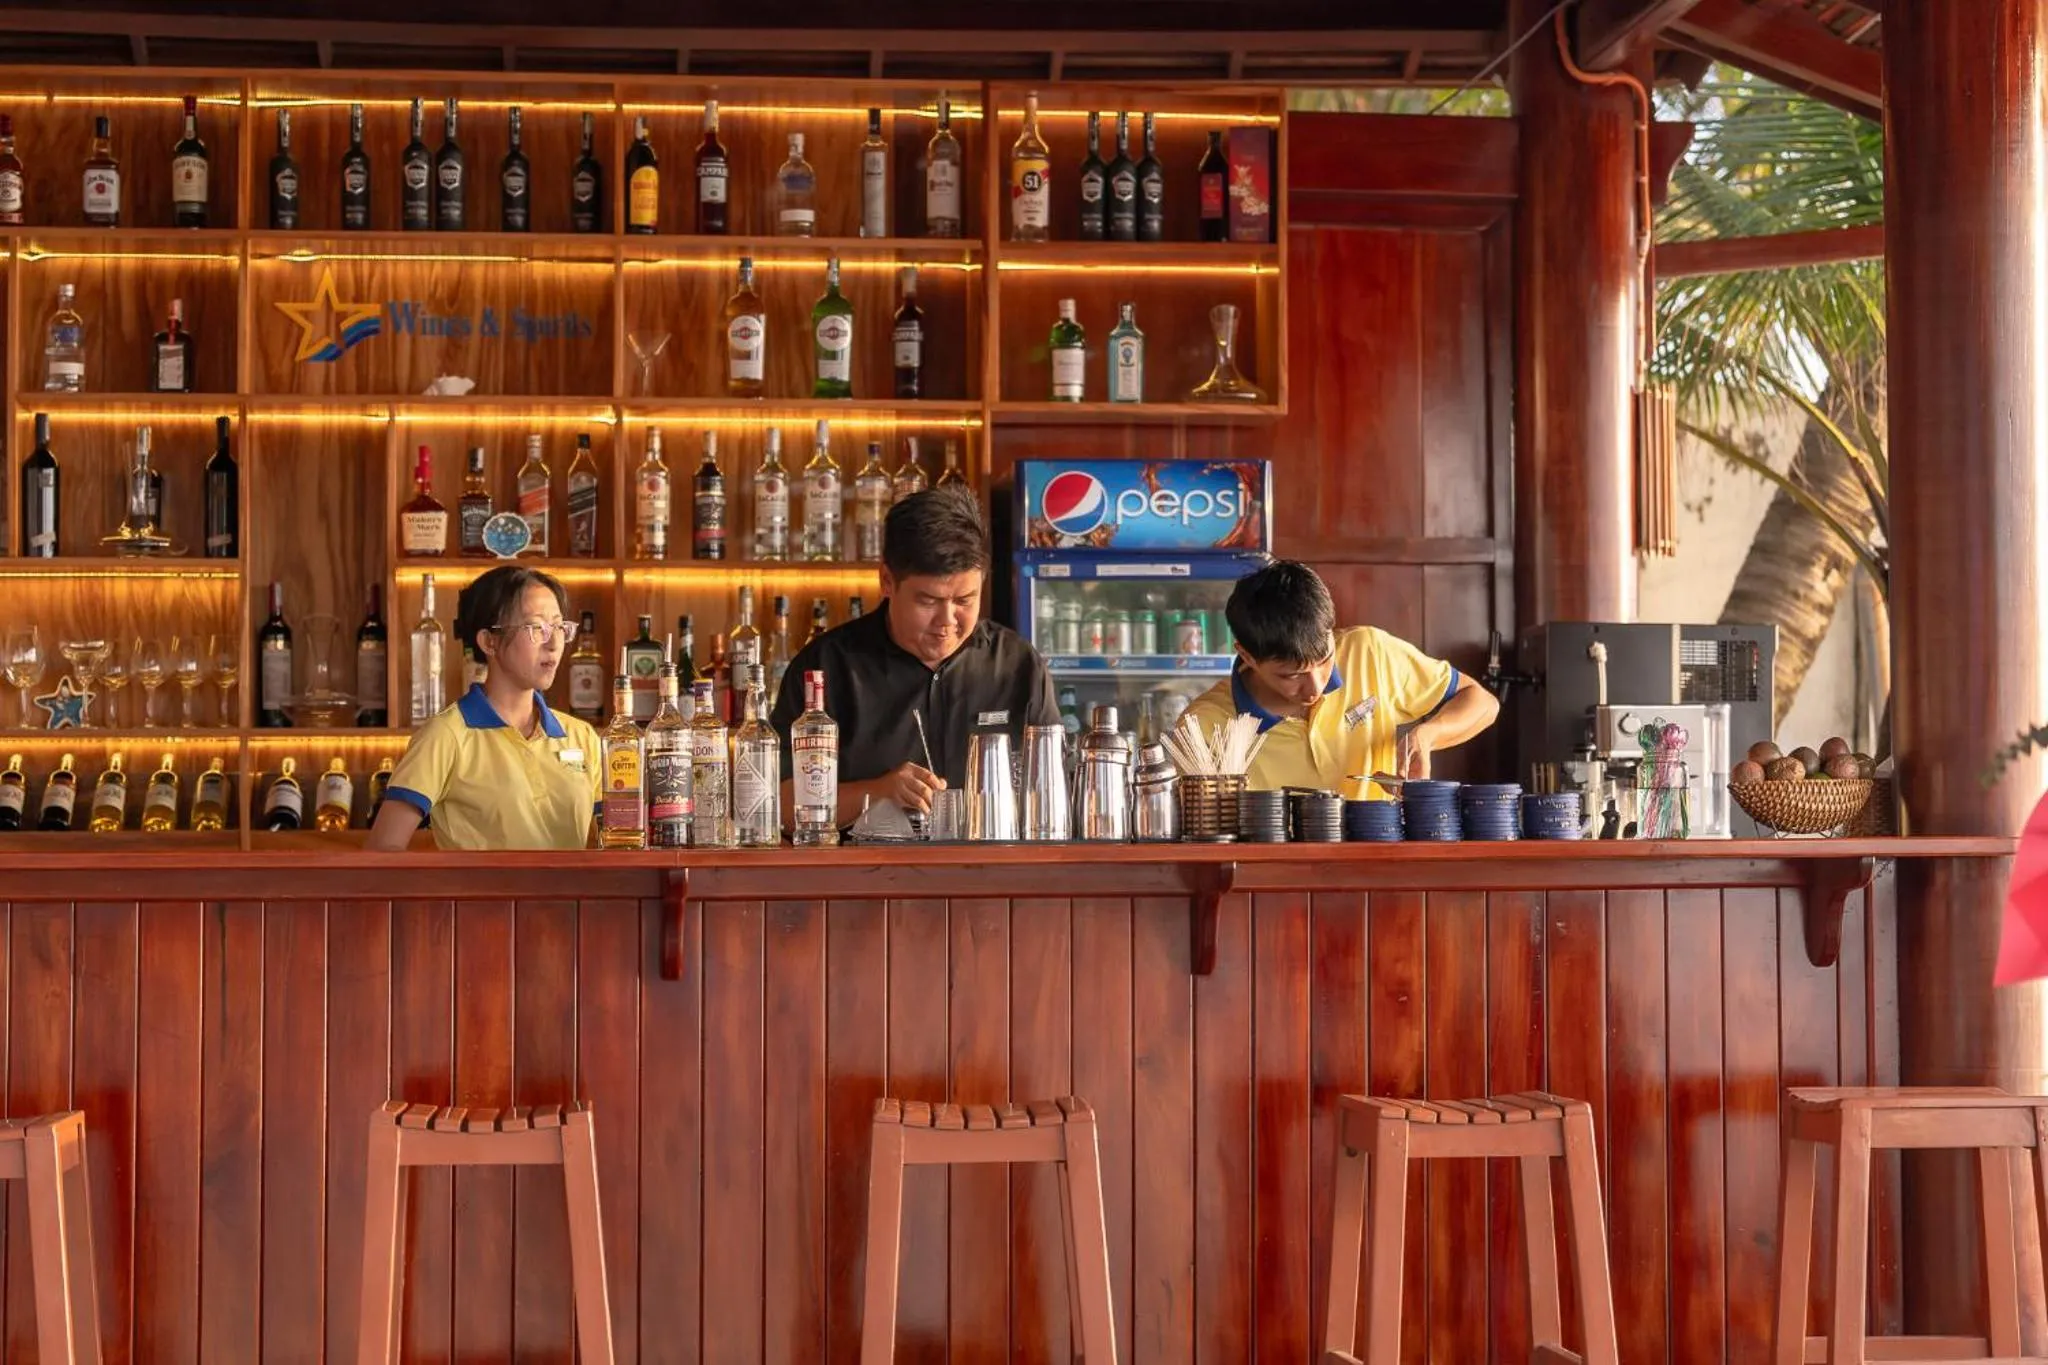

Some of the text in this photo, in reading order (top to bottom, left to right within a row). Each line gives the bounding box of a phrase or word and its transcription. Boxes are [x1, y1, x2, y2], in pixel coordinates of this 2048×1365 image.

[1024, 174, 1039, 189] 51
[388, 299, 592, 343] Wines & Spirits
[1117, 483, 1244, 525] pepsi
